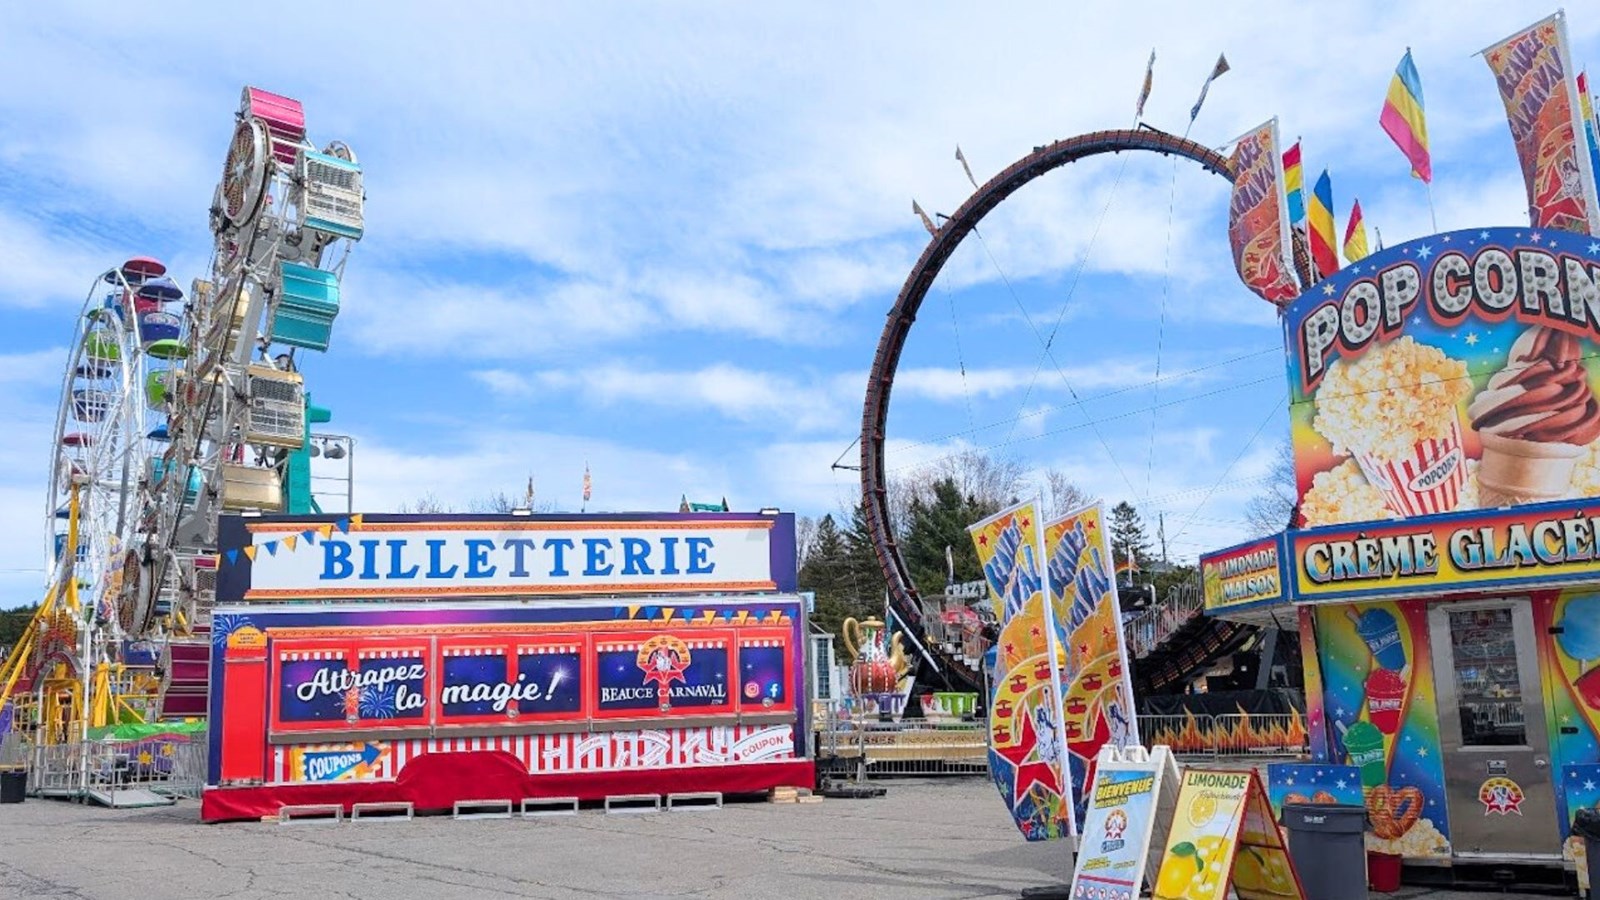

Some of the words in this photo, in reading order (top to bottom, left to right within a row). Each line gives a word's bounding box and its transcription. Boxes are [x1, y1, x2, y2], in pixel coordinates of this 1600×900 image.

[1304, 264, 1420, 382] POP
[1432, 248, 1600, 328] CORN
[1418, 453, 1457, 487] POPCORN
[319, 537, 716, 580] BILLETTERIE
[1305, 531, 1438, 583] CRÈME
[1450, 510, 1600, 569] GLACÉ
[1219, 547, 1277, 579] LIMONADE
[1223, 573, 1278, 602] MAISON
[297, 664, 427, 701] Attrapez
[601, 687, 654, 703] BEAUCE
[657, 684, 726, 699] CARNAVAL
[395, 685, 427, 710] la
[742, 736, 784, 758] COUPON
[309, 753, 362, 781] COUPONS
[1188, 773, 1247, 789] LIMONADE
[1097, 777, 1154, 800] BIENVENUE
